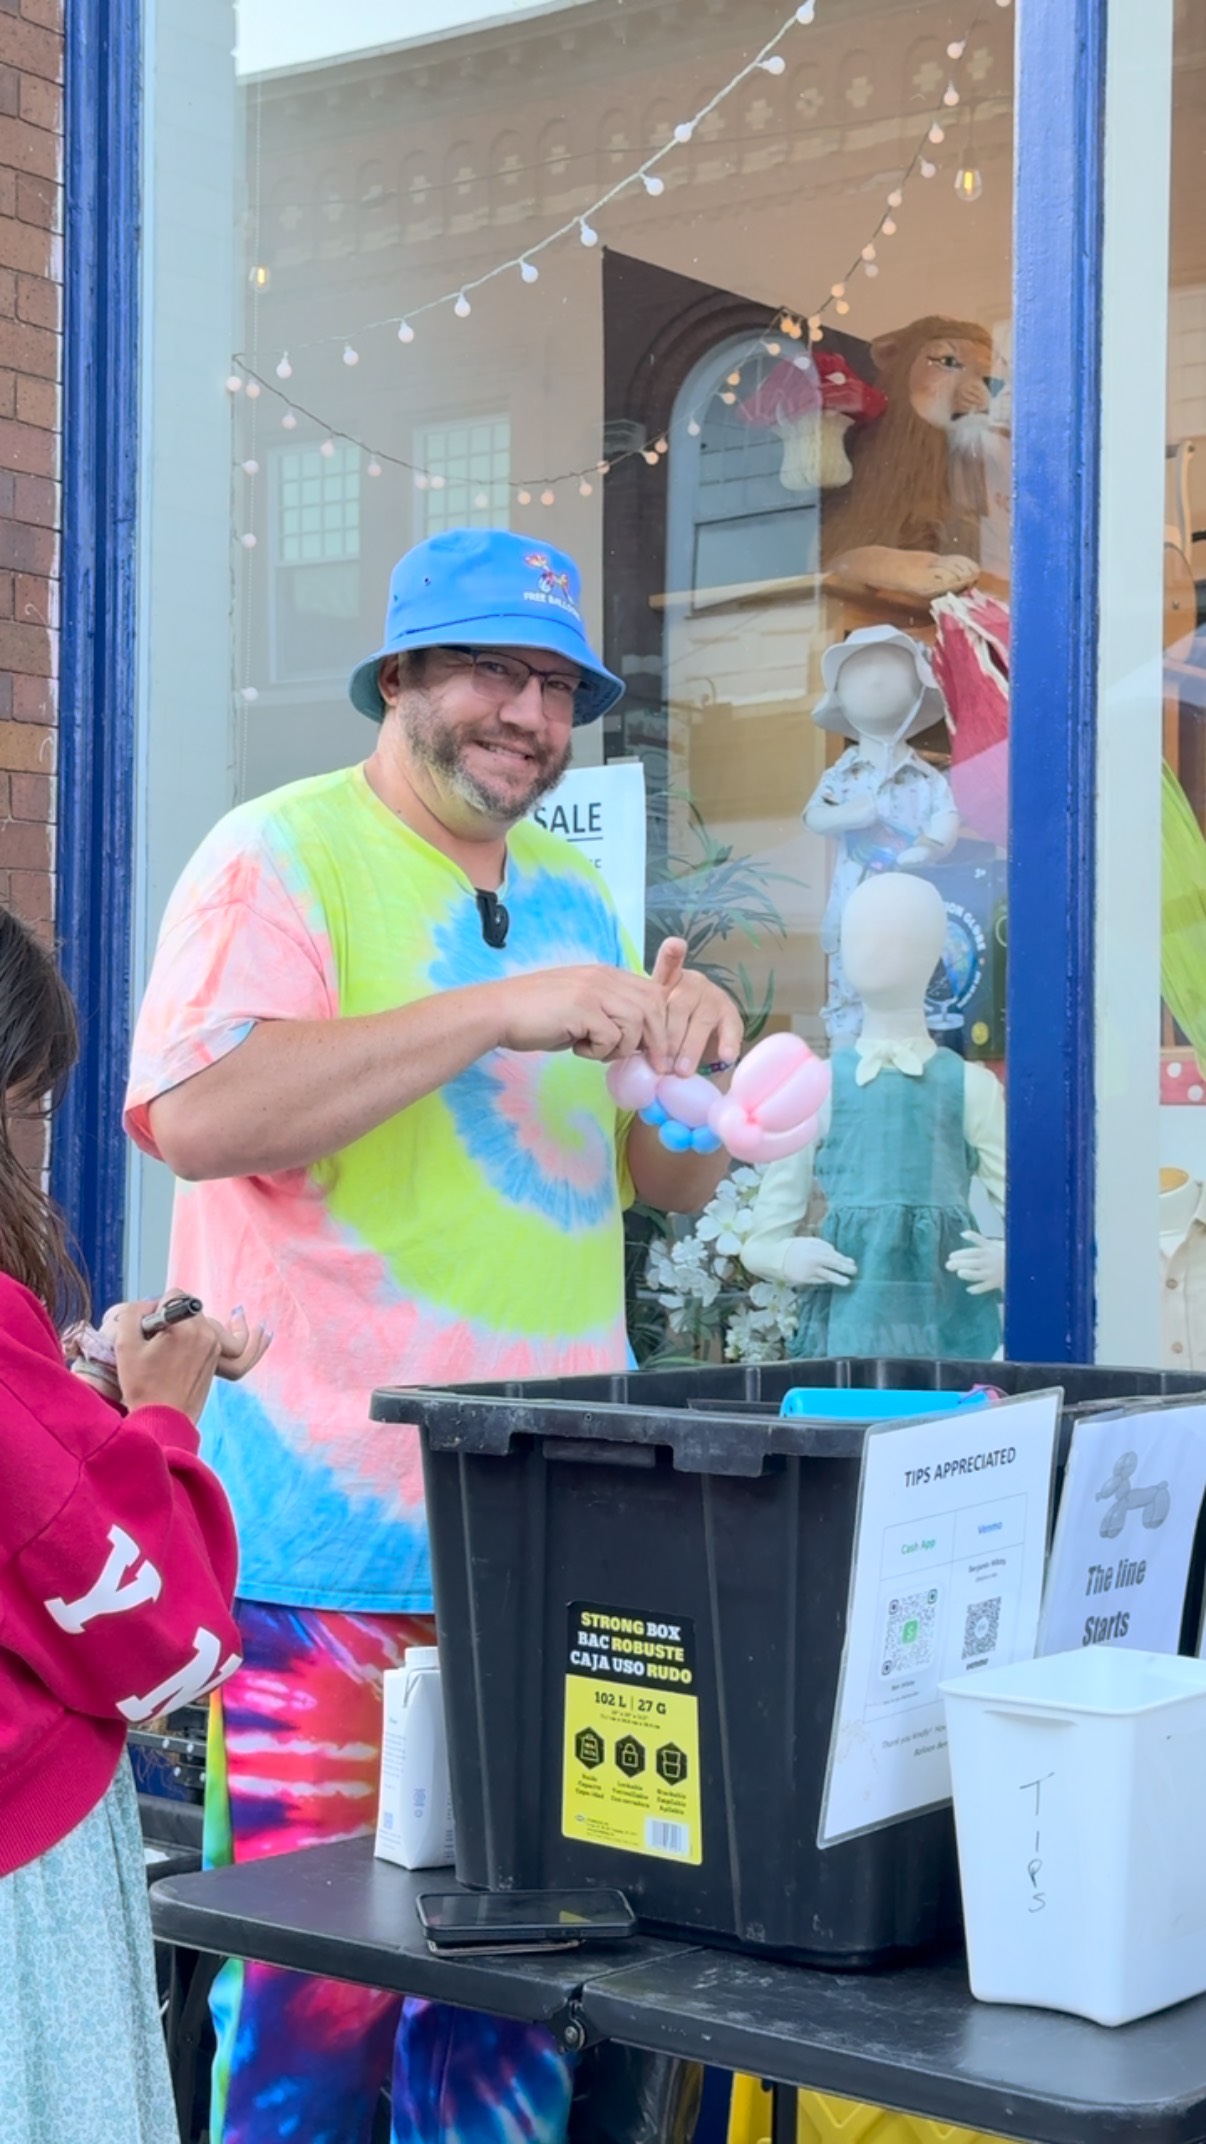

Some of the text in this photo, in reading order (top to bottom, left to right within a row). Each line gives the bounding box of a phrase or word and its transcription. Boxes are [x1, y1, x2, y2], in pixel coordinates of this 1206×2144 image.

[523, 592, 547, 602] FREE
[533, 802, 602, 834] SALE
[963, 912, 987, 951] GLOBE
[904, 1447, 1017, 1488] TIPS APPRECIATED
[977, 1522, 1003, 1535] Venmo
[901, 1539, 937, 1555] Cash App
[1085, 1558, 1147, 1597] The line
[581, 1611, 682, 1642] STRONG BOX
[1081, 1611, 1131, 1648] Starts
[577, 1631, 685, 1663] BAC ROBUSTE
[569, 1650, 693, 1685] CAJA USO RUDO
[594, 1691, 616, 1706] 102
[618, 1695, 627, 1709] L
[637, 1699, 654, 1713] 27
[656, 1703, 667, 1715] G
[1019, 1771, 1055, 1914] TIPS
